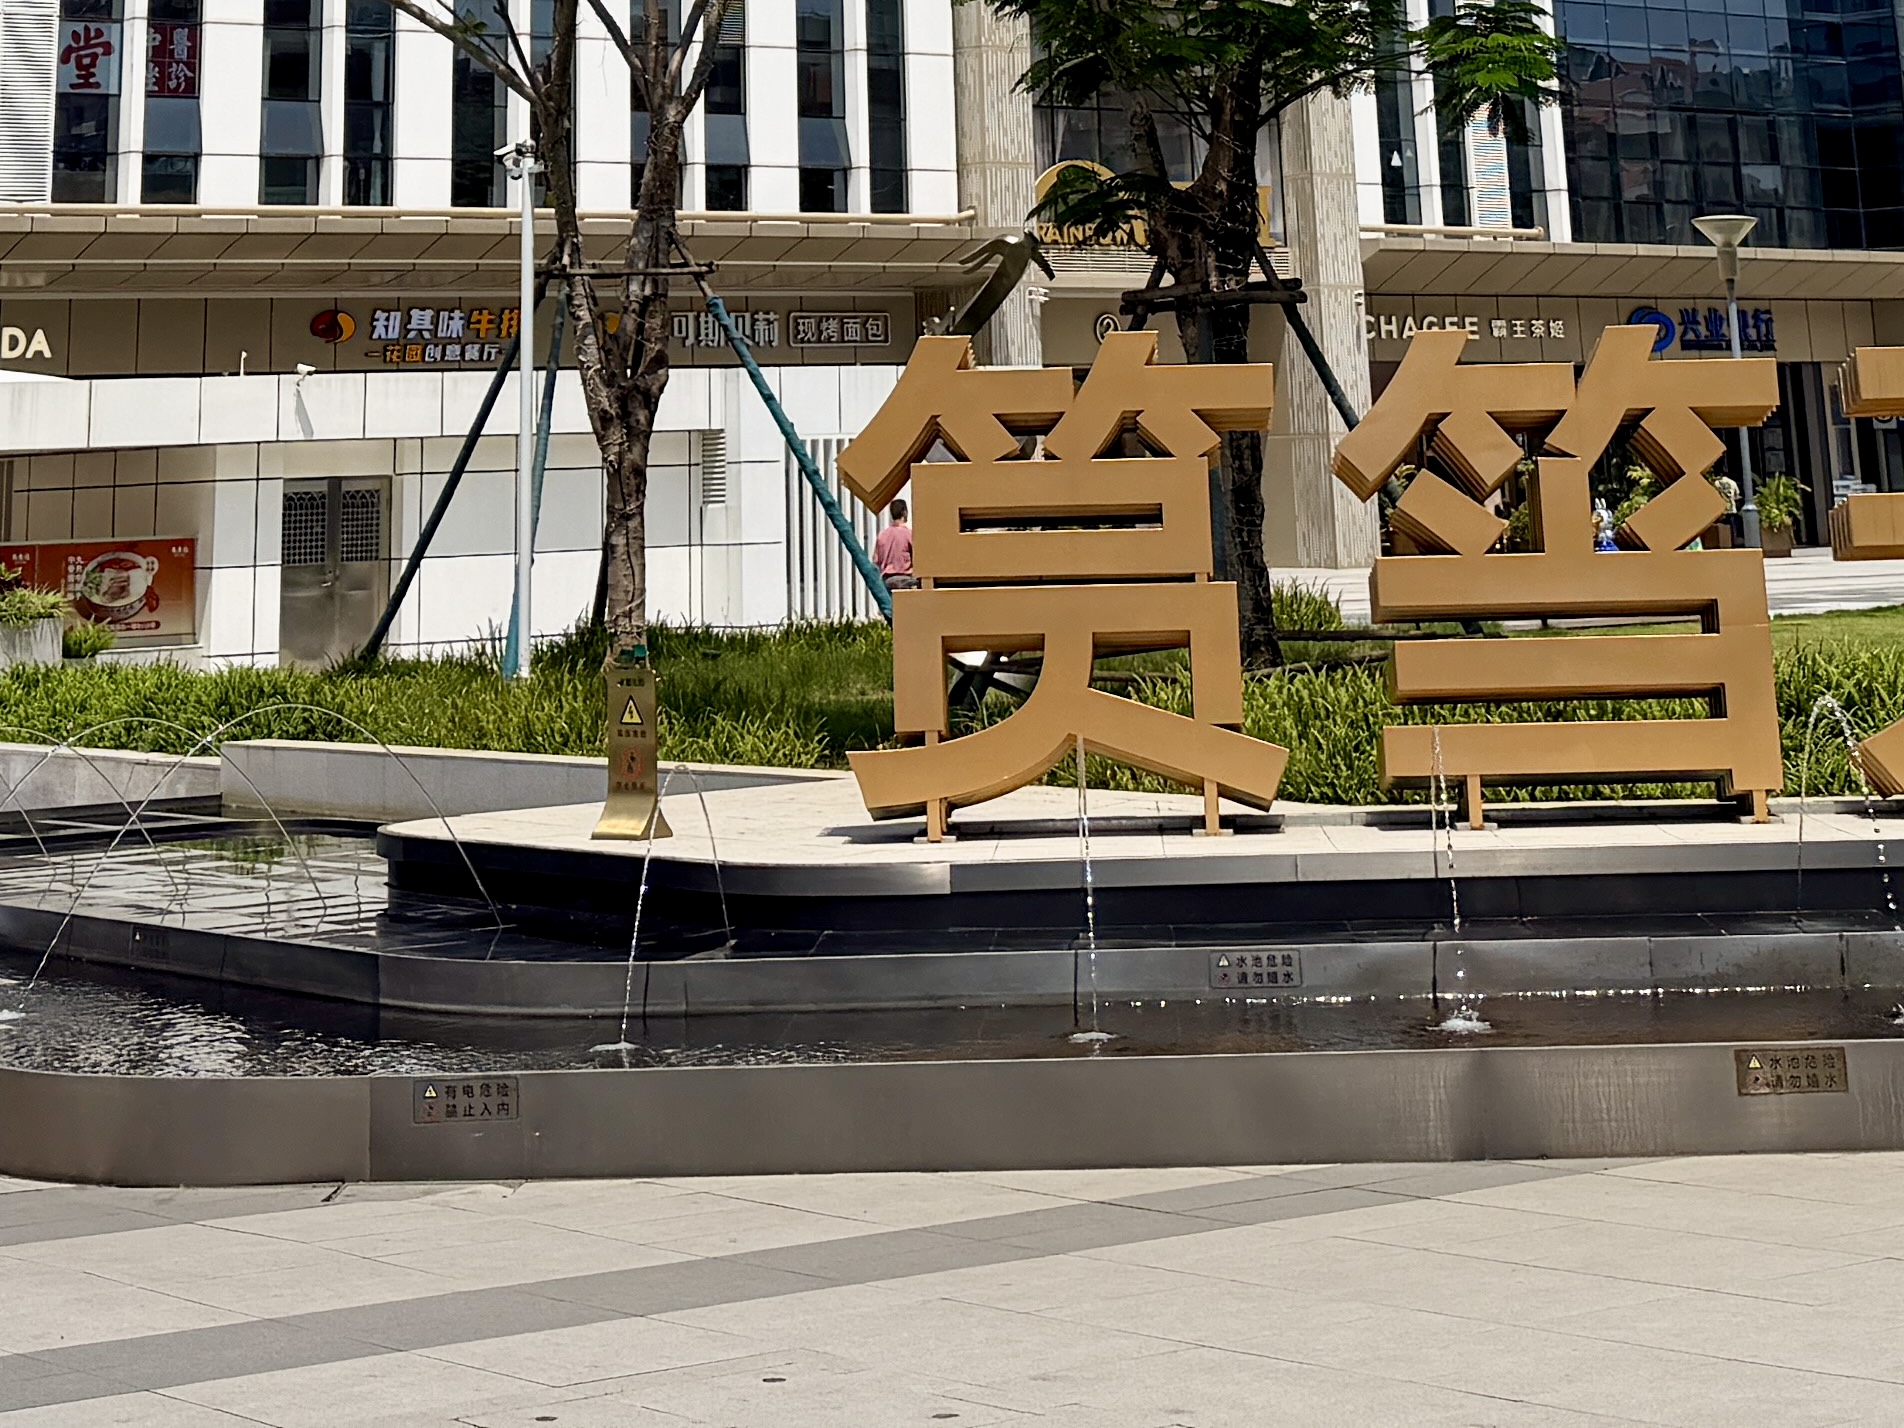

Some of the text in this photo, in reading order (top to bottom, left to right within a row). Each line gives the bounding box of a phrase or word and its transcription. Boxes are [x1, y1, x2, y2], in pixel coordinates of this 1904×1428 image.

[796, 318, 885, 342] 现烤面包
[1490, 319, 1566, 339] 霸王茶姬
[444, 1082, 510, 1100] 有电危险
[445, 1101, 510, 1118] 禁止入内
